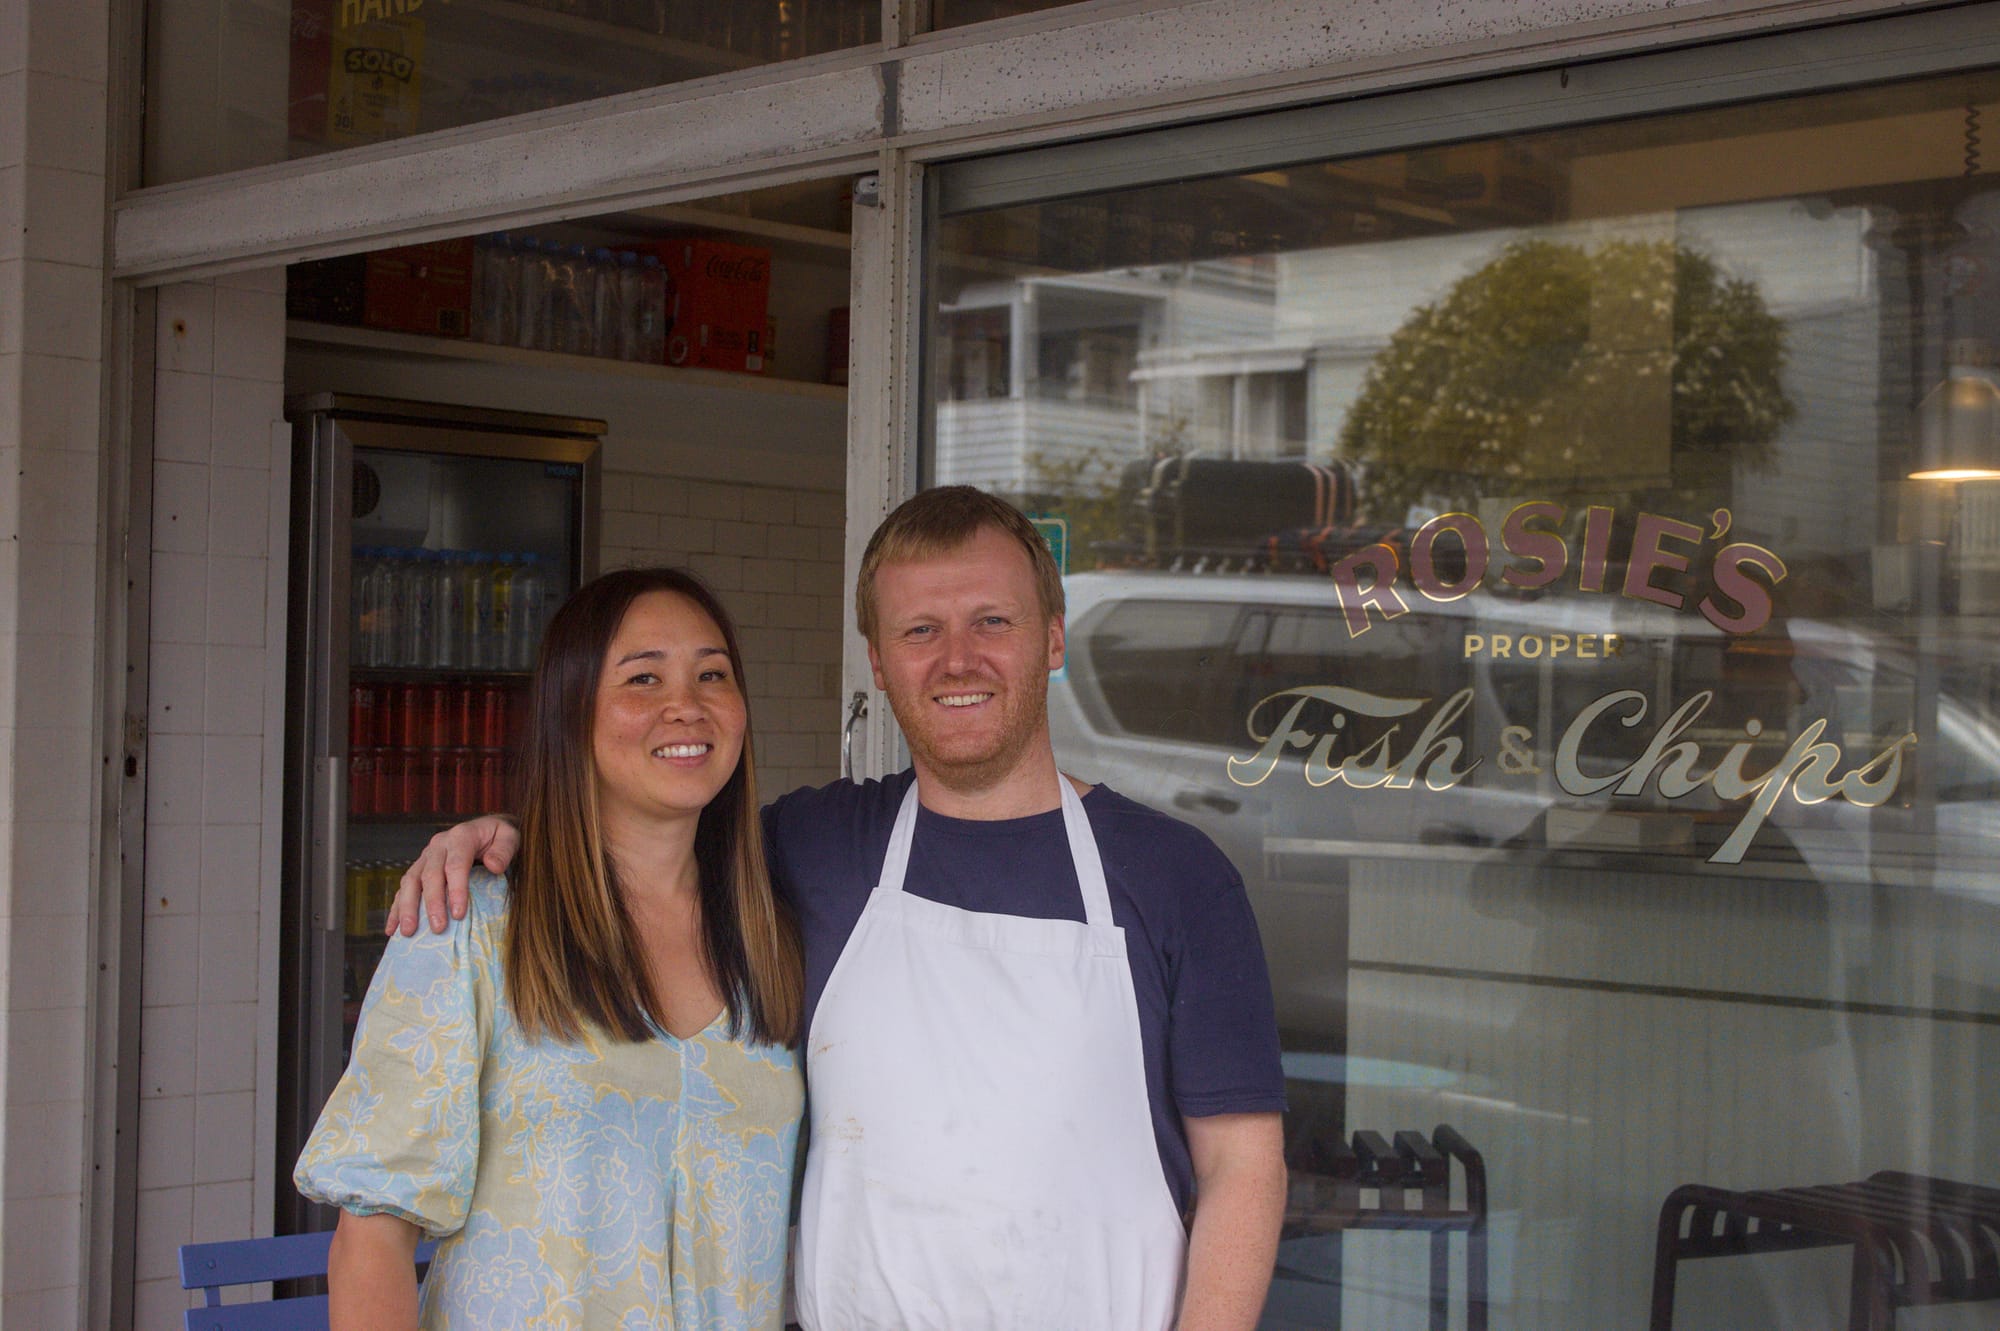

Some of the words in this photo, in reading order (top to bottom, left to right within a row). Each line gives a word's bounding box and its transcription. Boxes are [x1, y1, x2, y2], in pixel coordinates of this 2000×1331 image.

[341, 0, 424, 28] HA
[345, 49, 413, 80] SOLO
[1331, 500, 1788, 638] ROSIE'S
[1464, 633, 1623, 658] PROPER
[1227, 685, 1484, 792] Fish
[1497, 725, 1544, 775] &
[1553, 690, 1918, 865] Chips
